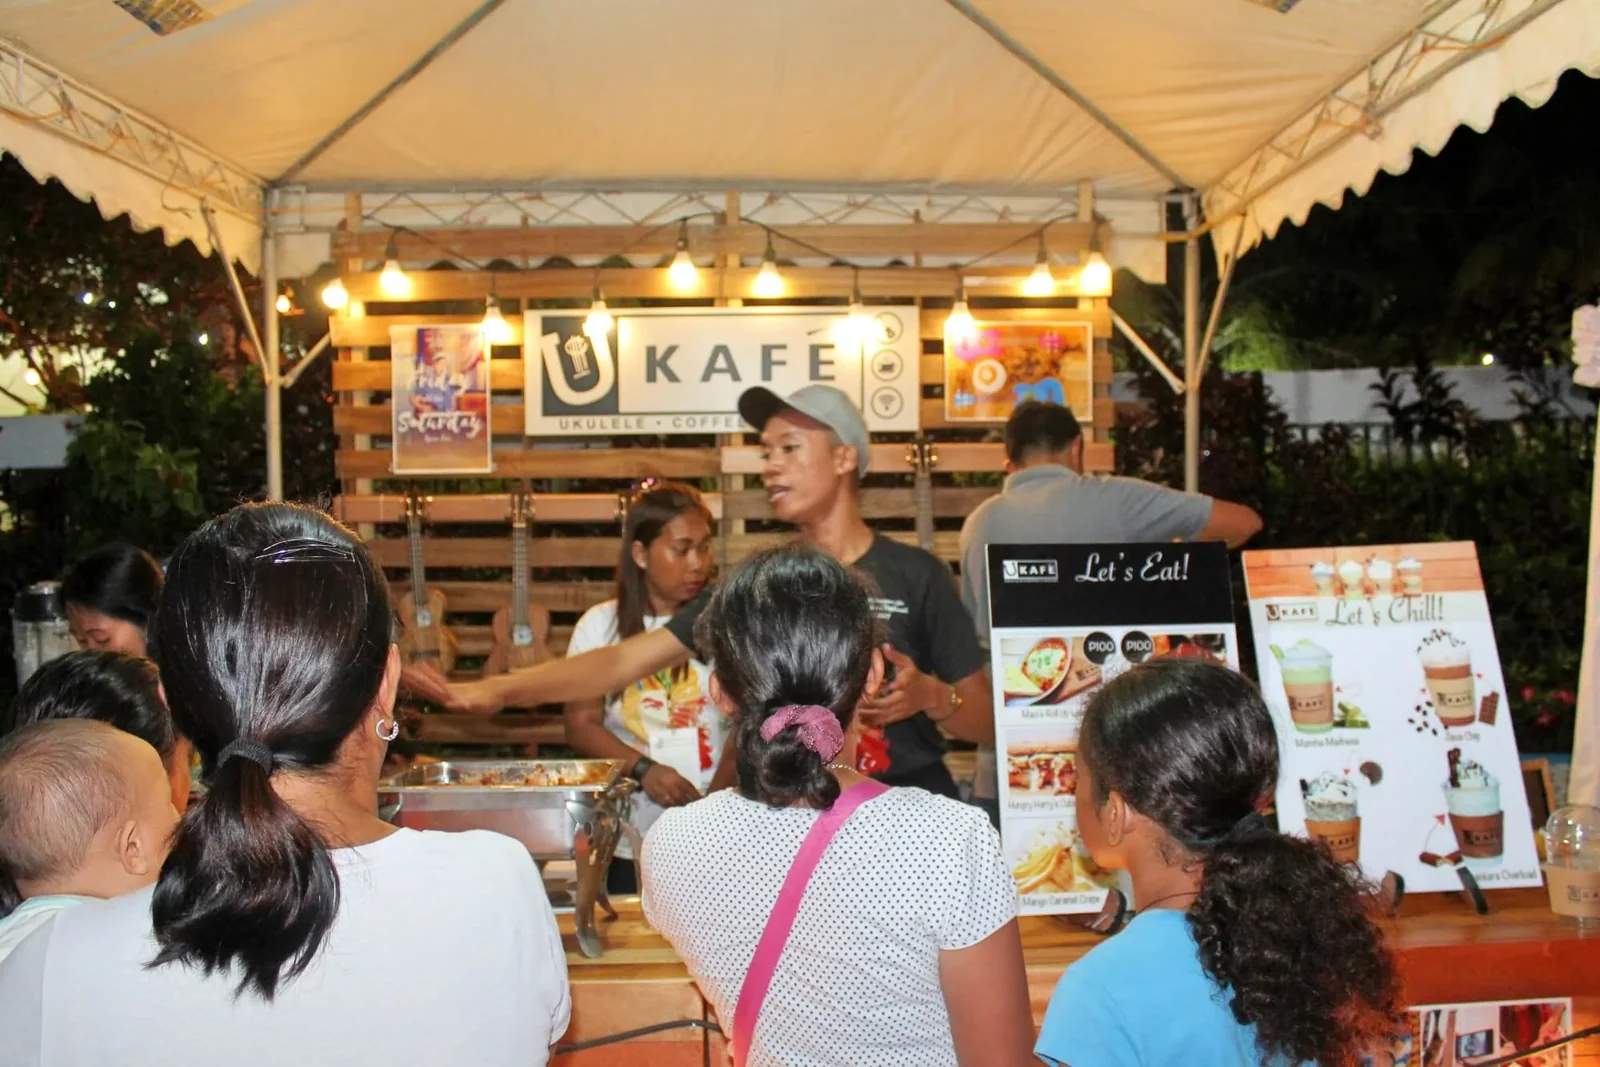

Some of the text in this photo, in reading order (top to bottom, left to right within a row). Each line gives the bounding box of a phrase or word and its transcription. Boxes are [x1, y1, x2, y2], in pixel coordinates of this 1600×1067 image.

[559, 417, 646, 430] UKULELE
[1074, 551, 1190, 582] Let's Eat!
[1388, 594, 1444, 624] Chill!
